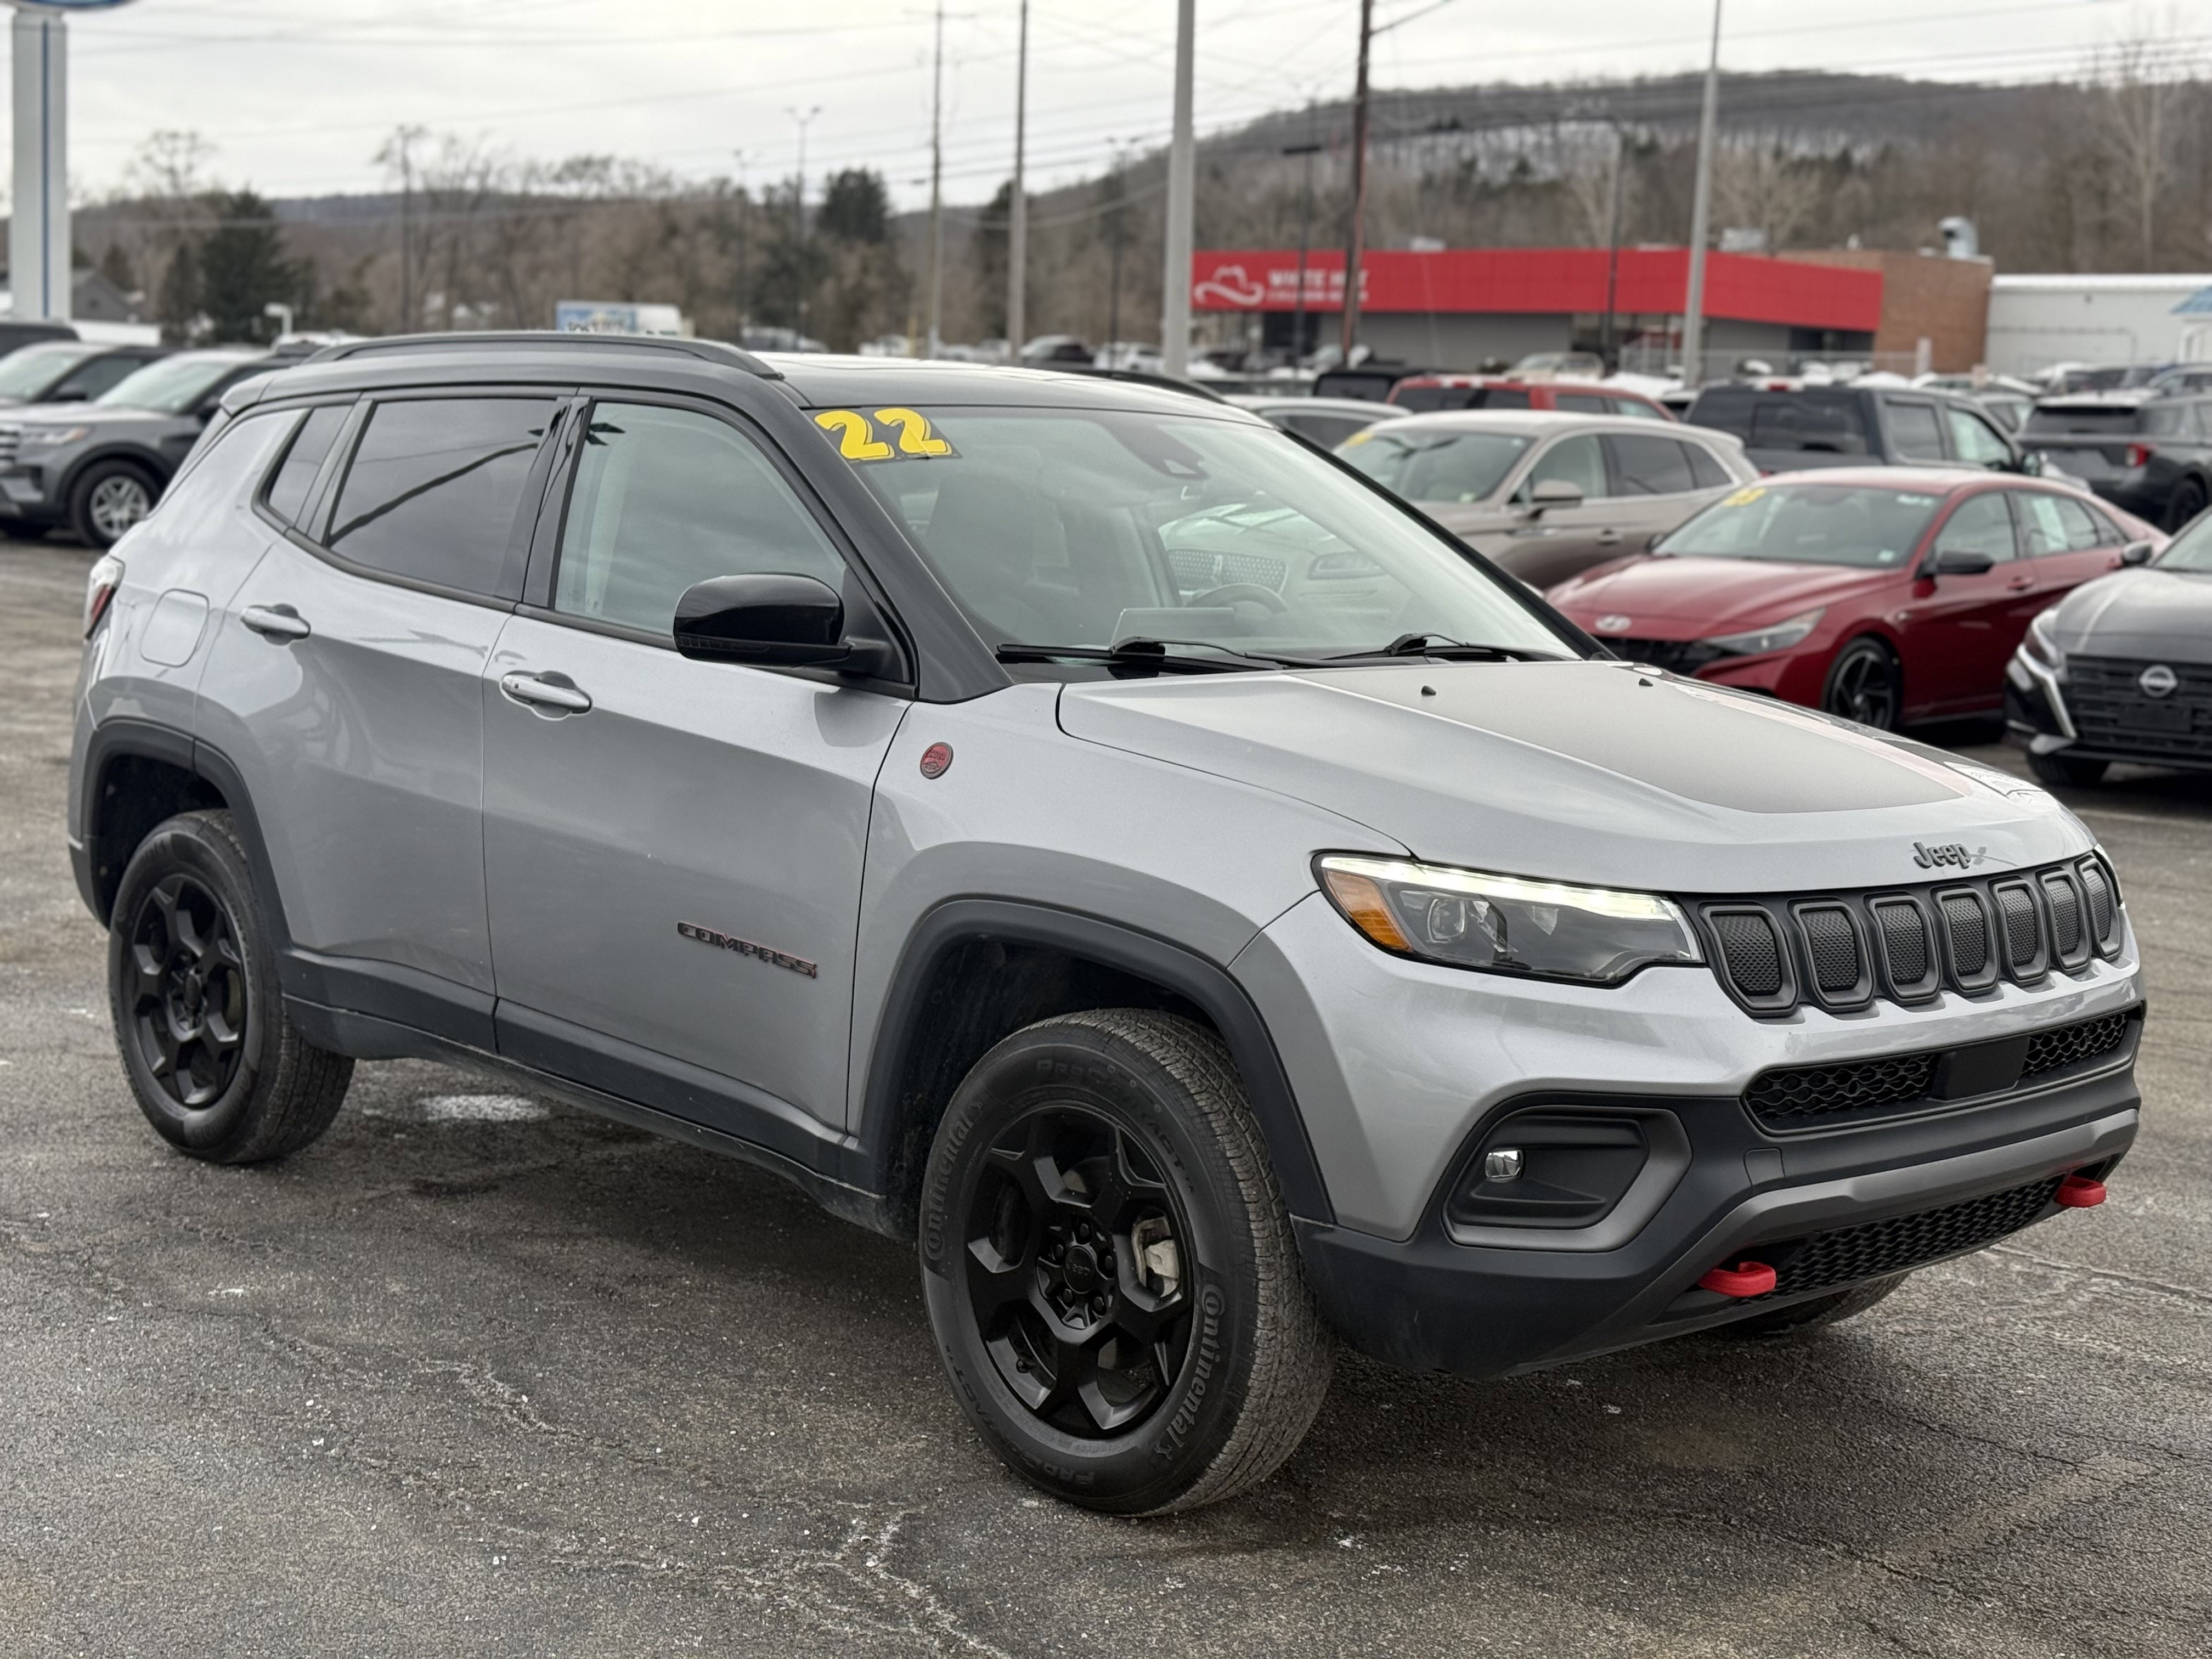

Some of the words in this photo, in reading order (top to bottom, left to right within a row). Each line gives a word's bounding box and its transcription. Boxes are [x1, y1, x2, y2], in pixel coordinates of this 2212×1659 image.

[815, 408, 952, 460] 22
[1914, 842, 1971, 869] Jeep
[678, 921, 817, 979] COMPASS
[926, 1109, 975, 1261] Continental
[1165, 1283, 1226, 1449] Continental
